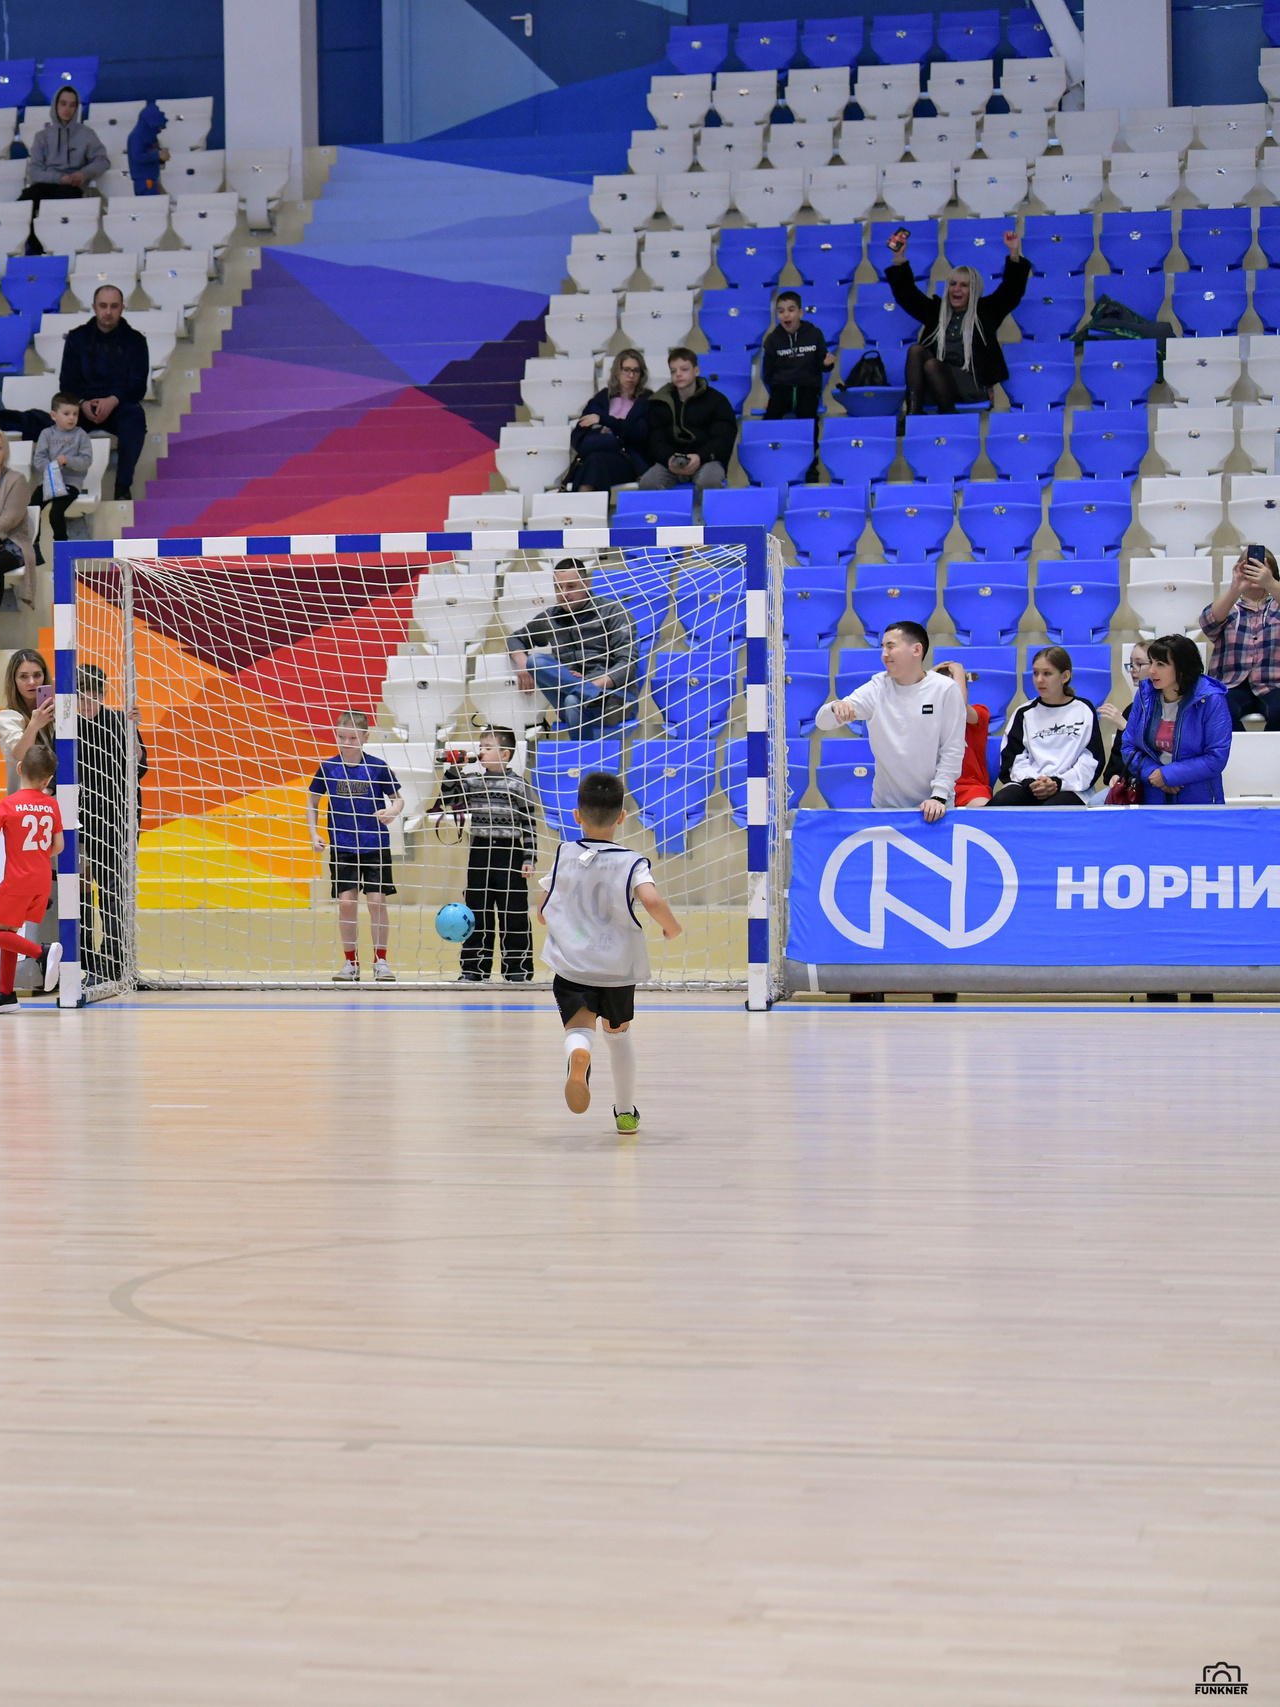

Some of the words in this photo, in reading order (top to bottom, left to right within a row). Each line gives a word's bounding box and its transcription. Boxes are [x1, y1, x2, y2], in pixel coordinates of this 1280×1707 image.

[15, 804, 54, 813] НАЗАРОВ
[21, 814, 54, 851] 23
[570, 880, 614, 927] 10
[1056, 864, 1280, 910] НОРНИ
